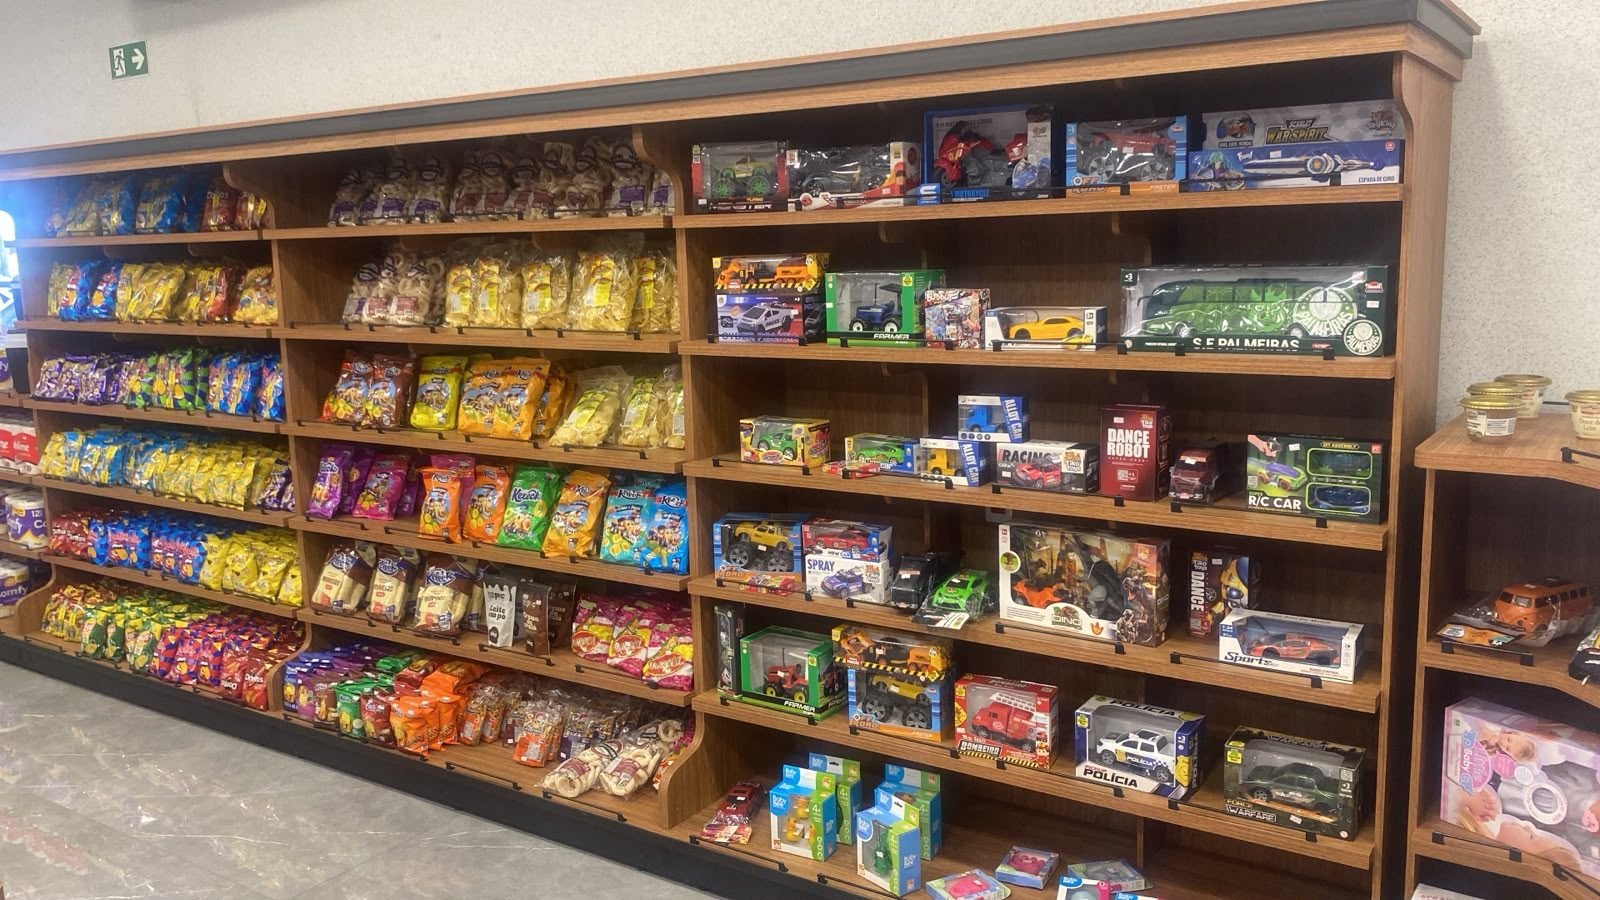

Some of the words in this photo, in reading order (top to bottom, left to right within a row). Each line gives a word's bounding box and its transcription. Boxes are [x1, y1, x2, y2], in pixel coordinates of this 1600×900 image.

[1107, 428, 1150, 445] DANCE
[1107, 442, 1150, 459] ROBOT
[1248, 495, 1270, 507] R/C
[1273, 497, 1301, 510] CAR
[807, 558, 835, 571] SPRAY
[1191, 570, 1205, 612] DANCE
[1224, 651, 1272, 666] Sports
[244, 673, 264, 683] Doritos
[784, 700, 816, 713] FARMER
[960, 741, 1000, 755] BOMBEIRO
[1461, 748, 1473, 773] Baby
[1084, 768, 1138, 788] POLÍCIA
